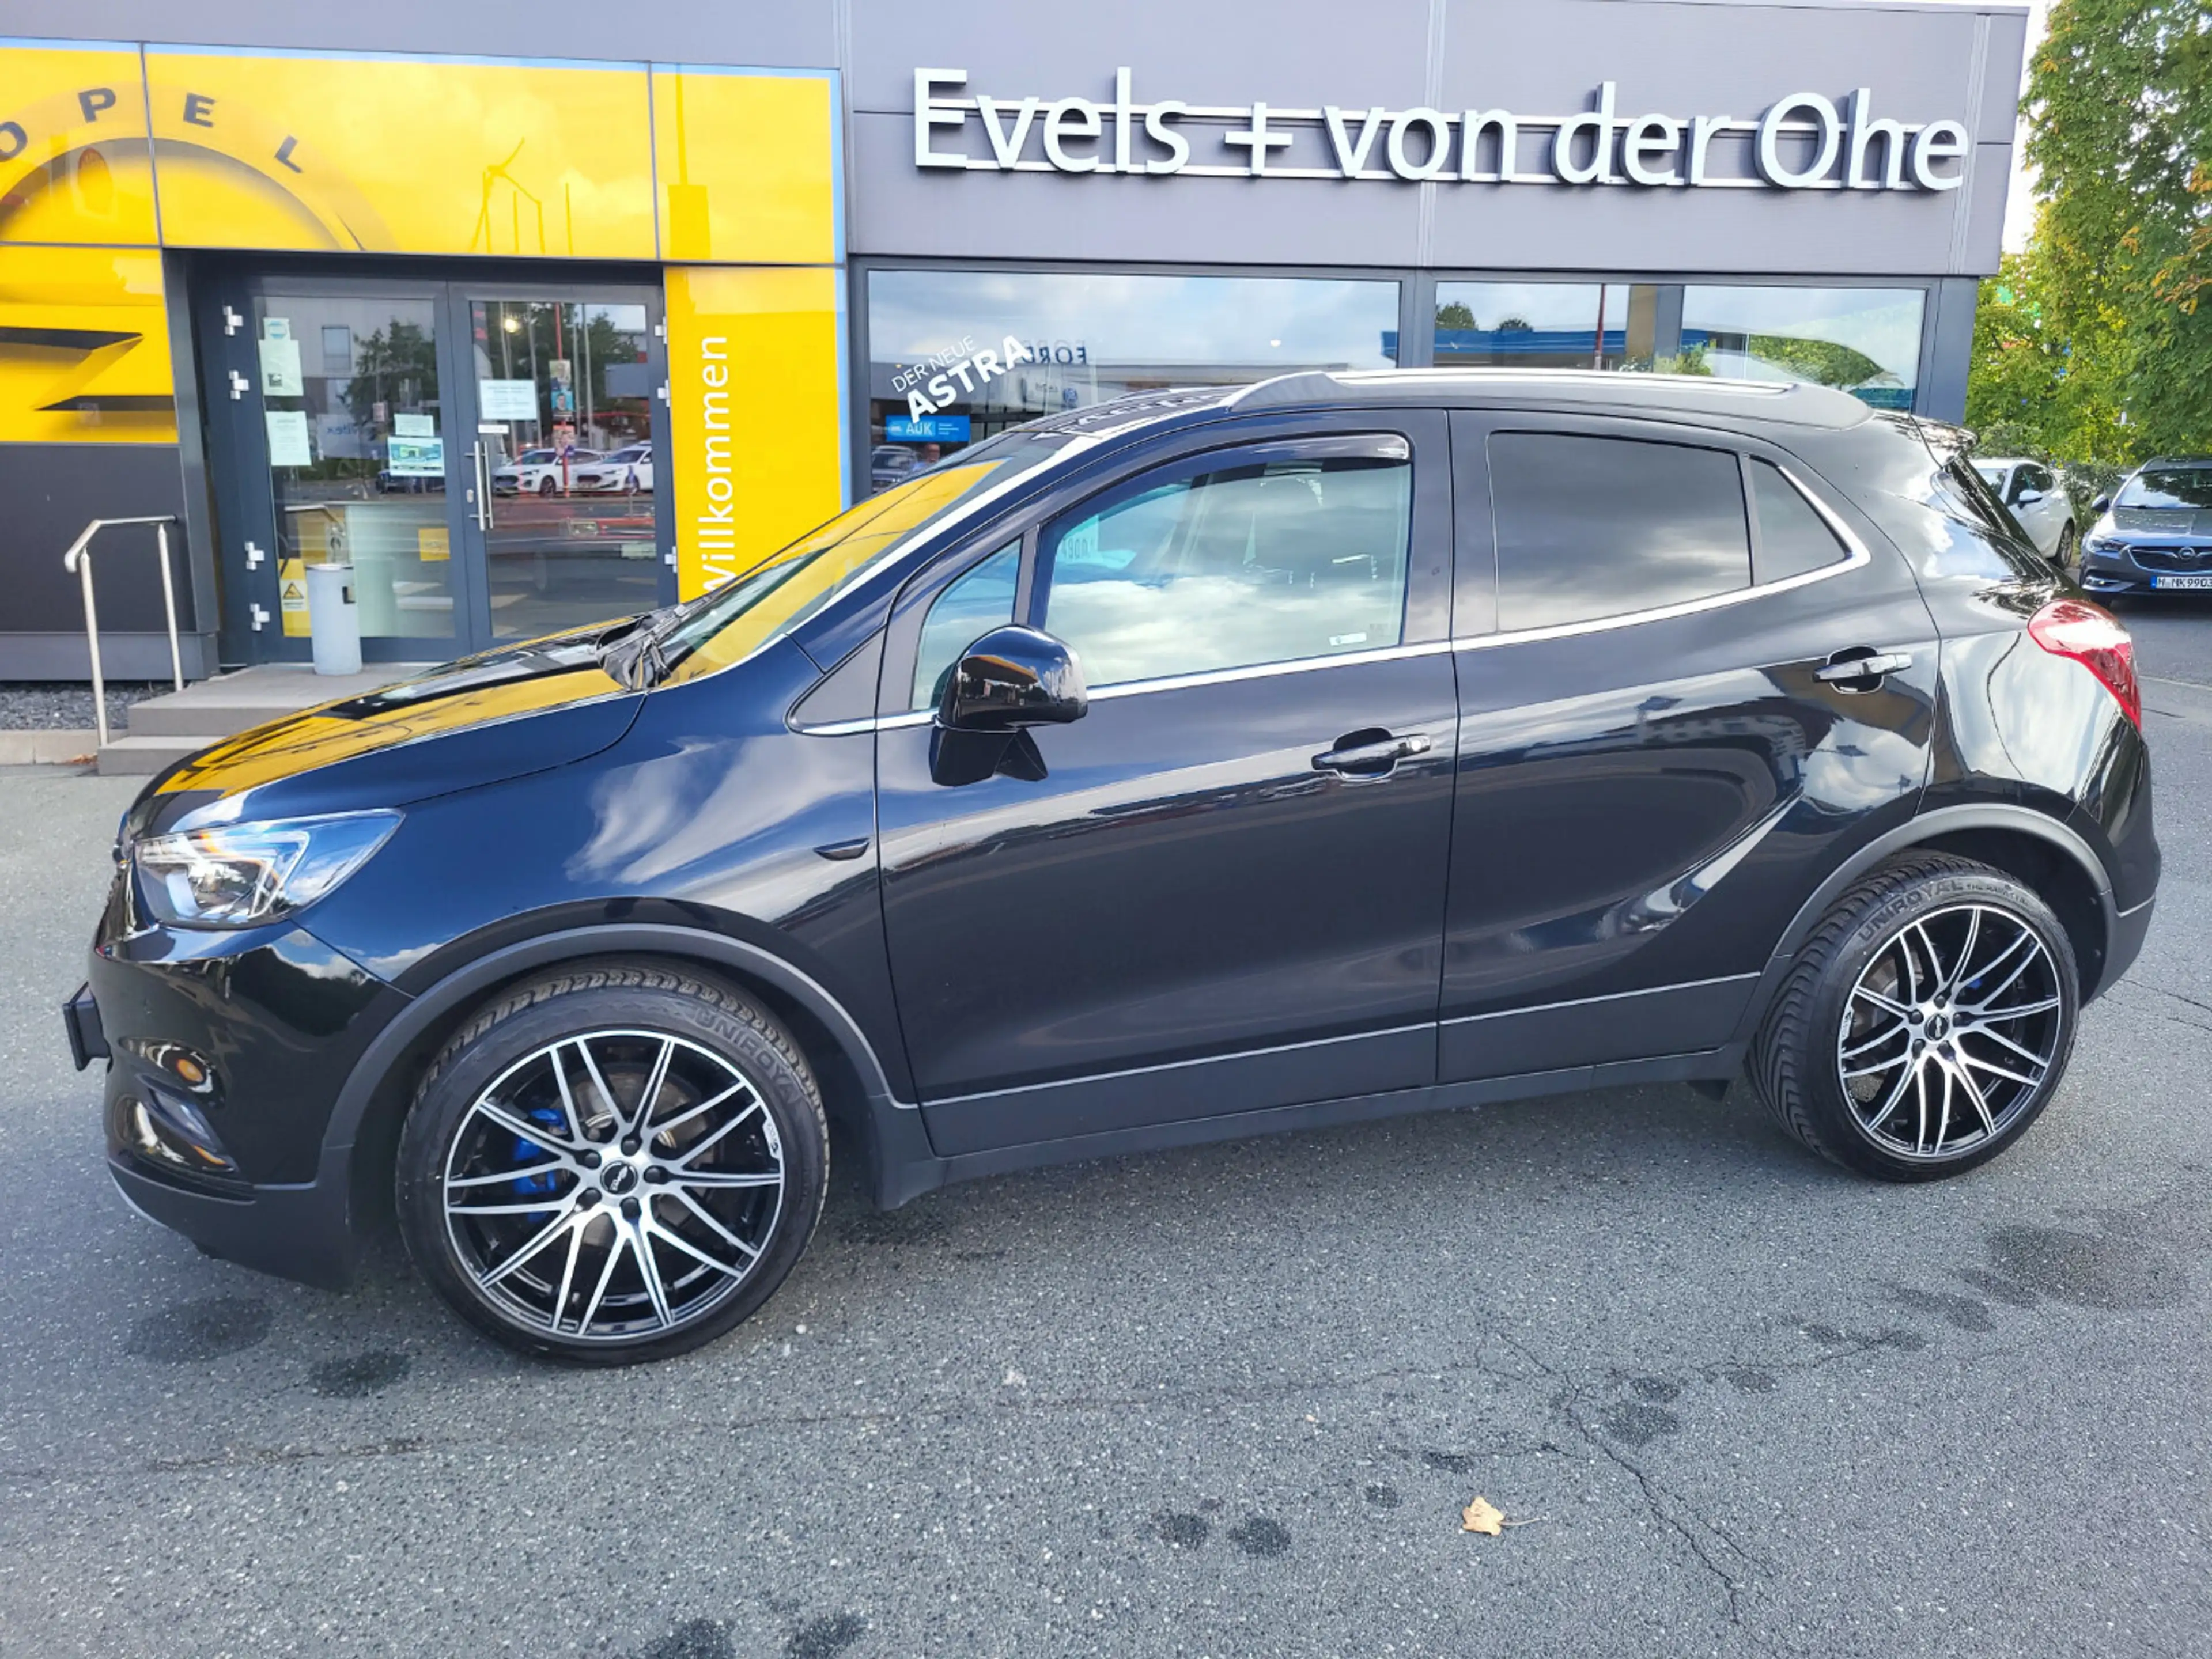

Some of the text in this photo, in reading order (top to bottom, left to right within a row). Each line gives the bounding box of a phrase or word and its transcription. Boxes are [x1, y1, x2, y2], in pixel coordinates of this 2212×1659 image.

[0, 86, 304, 174] OPEL
[914, 66, 1969, 191] Evels + von der Ohe
[891, 334, 975, 393] DER NEUE
[906, 335, 1034, 425] ASTRA
[1858, 879, 1964, 942] UNIROYAL
